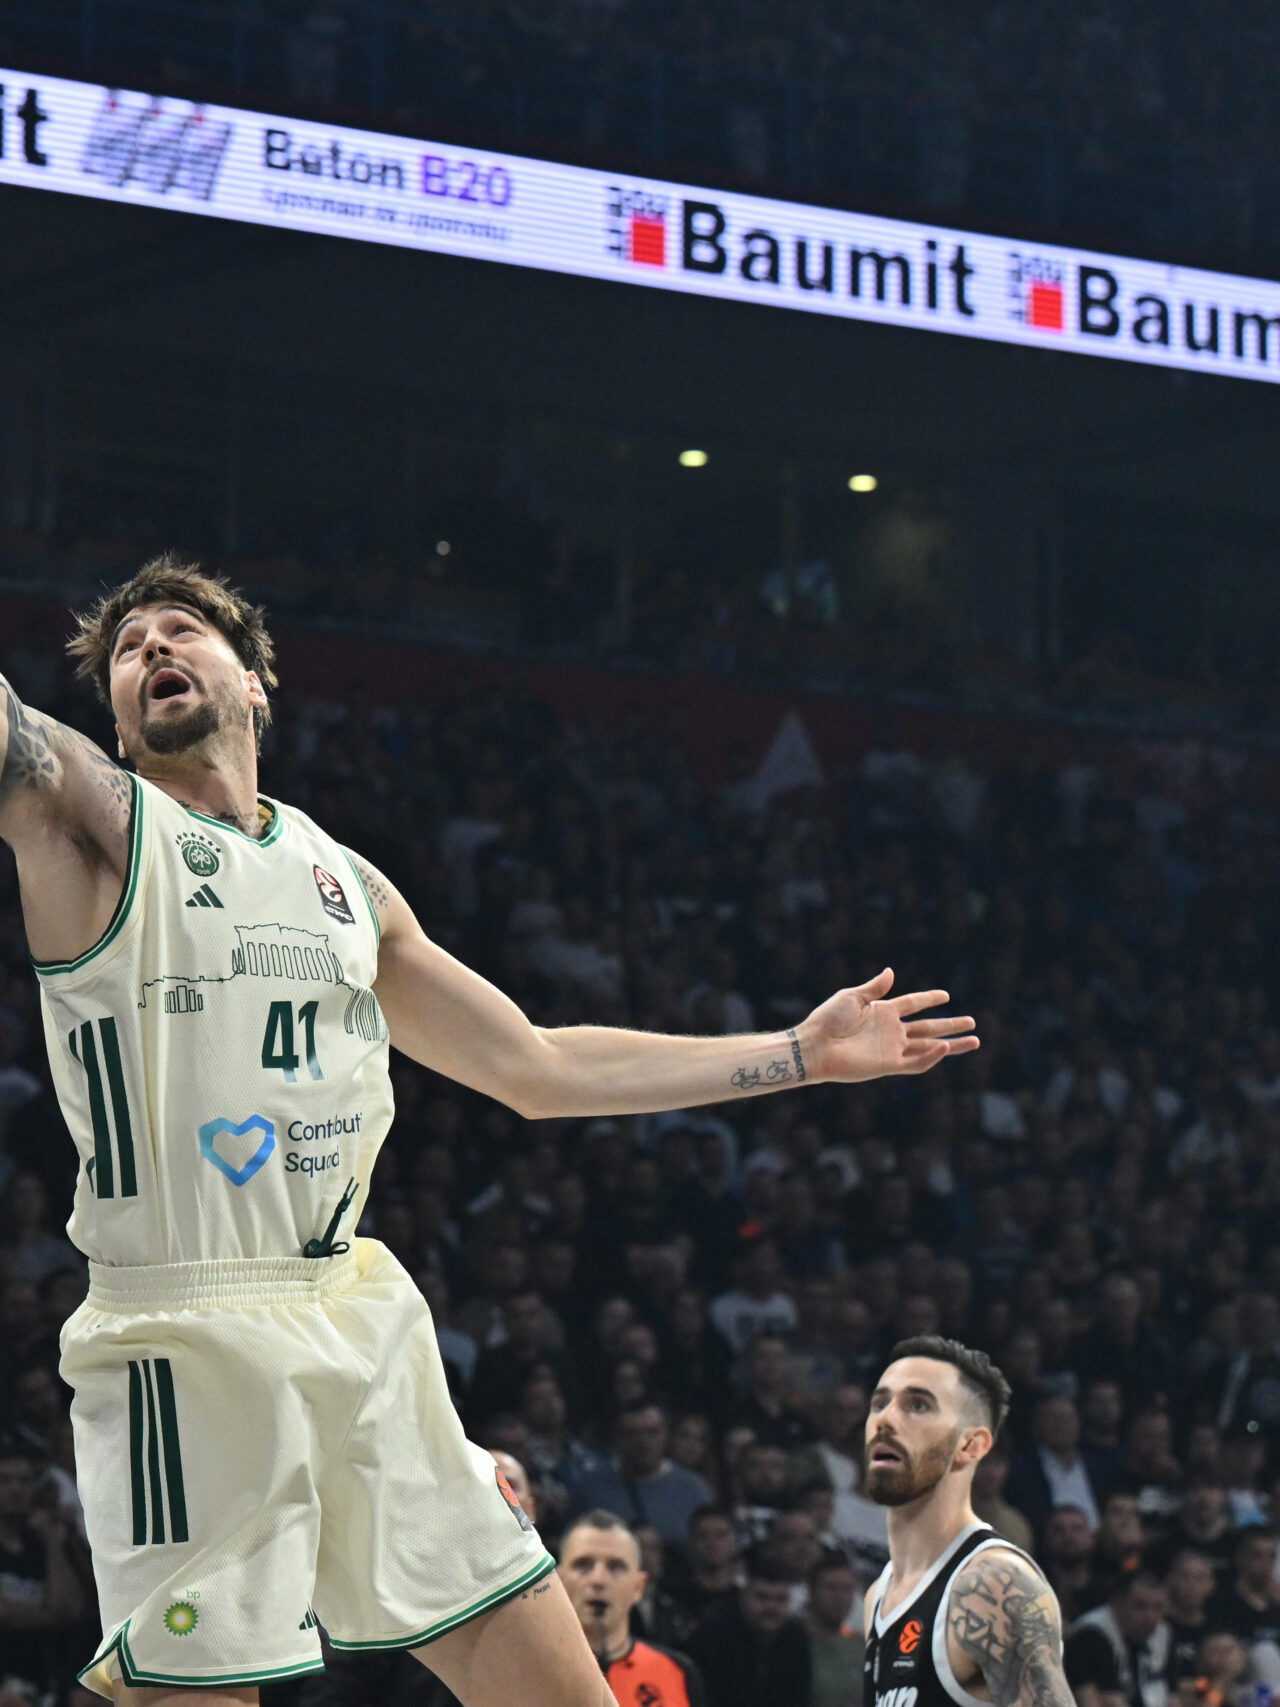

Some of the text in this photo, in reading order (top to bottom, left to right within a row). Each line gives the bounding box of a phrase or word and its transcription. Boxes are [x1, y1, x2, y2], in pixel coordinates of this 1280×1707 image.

[423, 155, 511, 207] B20
[682, 200, 975, 316] Baumit
[261, 1001, 325, 1084] 41
[186, 1589, 201, 1601] bp
